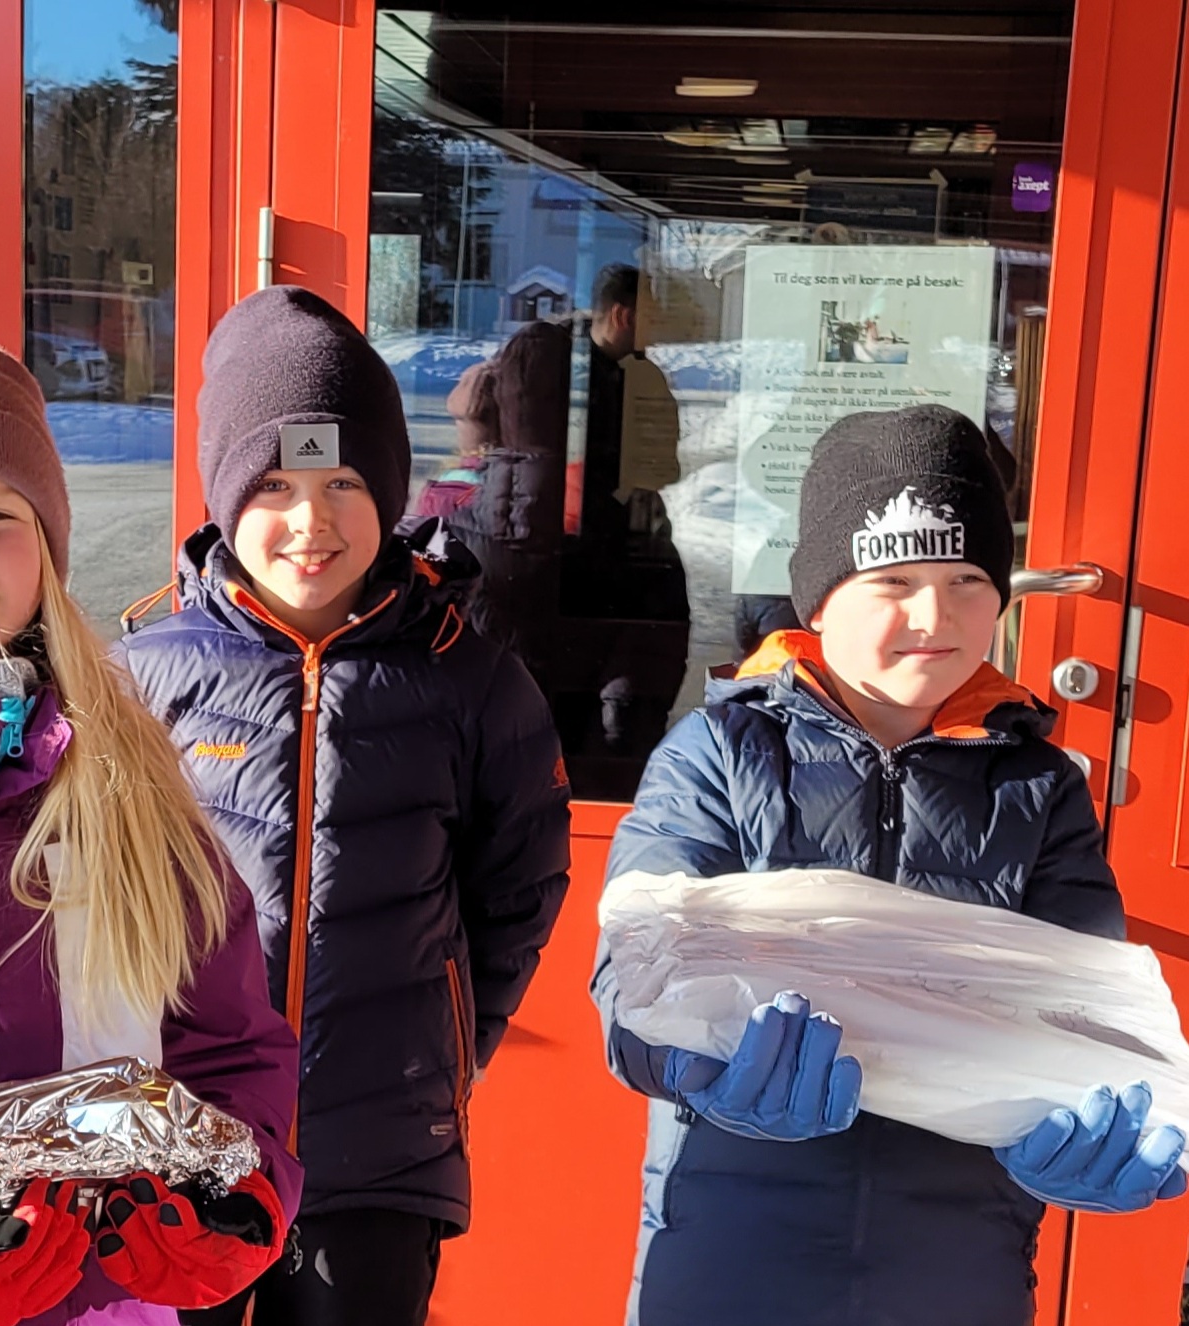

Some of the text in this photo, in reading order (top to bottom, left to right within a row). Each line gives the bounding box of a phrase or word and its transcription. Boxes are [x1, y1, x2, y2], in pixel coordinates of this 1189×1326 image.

[773, 272, 787, 284] Til
[790, 272, 811, 286] deg
[814, 275, 839, 285] som
[842, 273, 857, 285] vil
[859, 274, 904, 286] komme
[906, 275, 921, 288] på
[857, 527, 962, 566] FORTNITE
